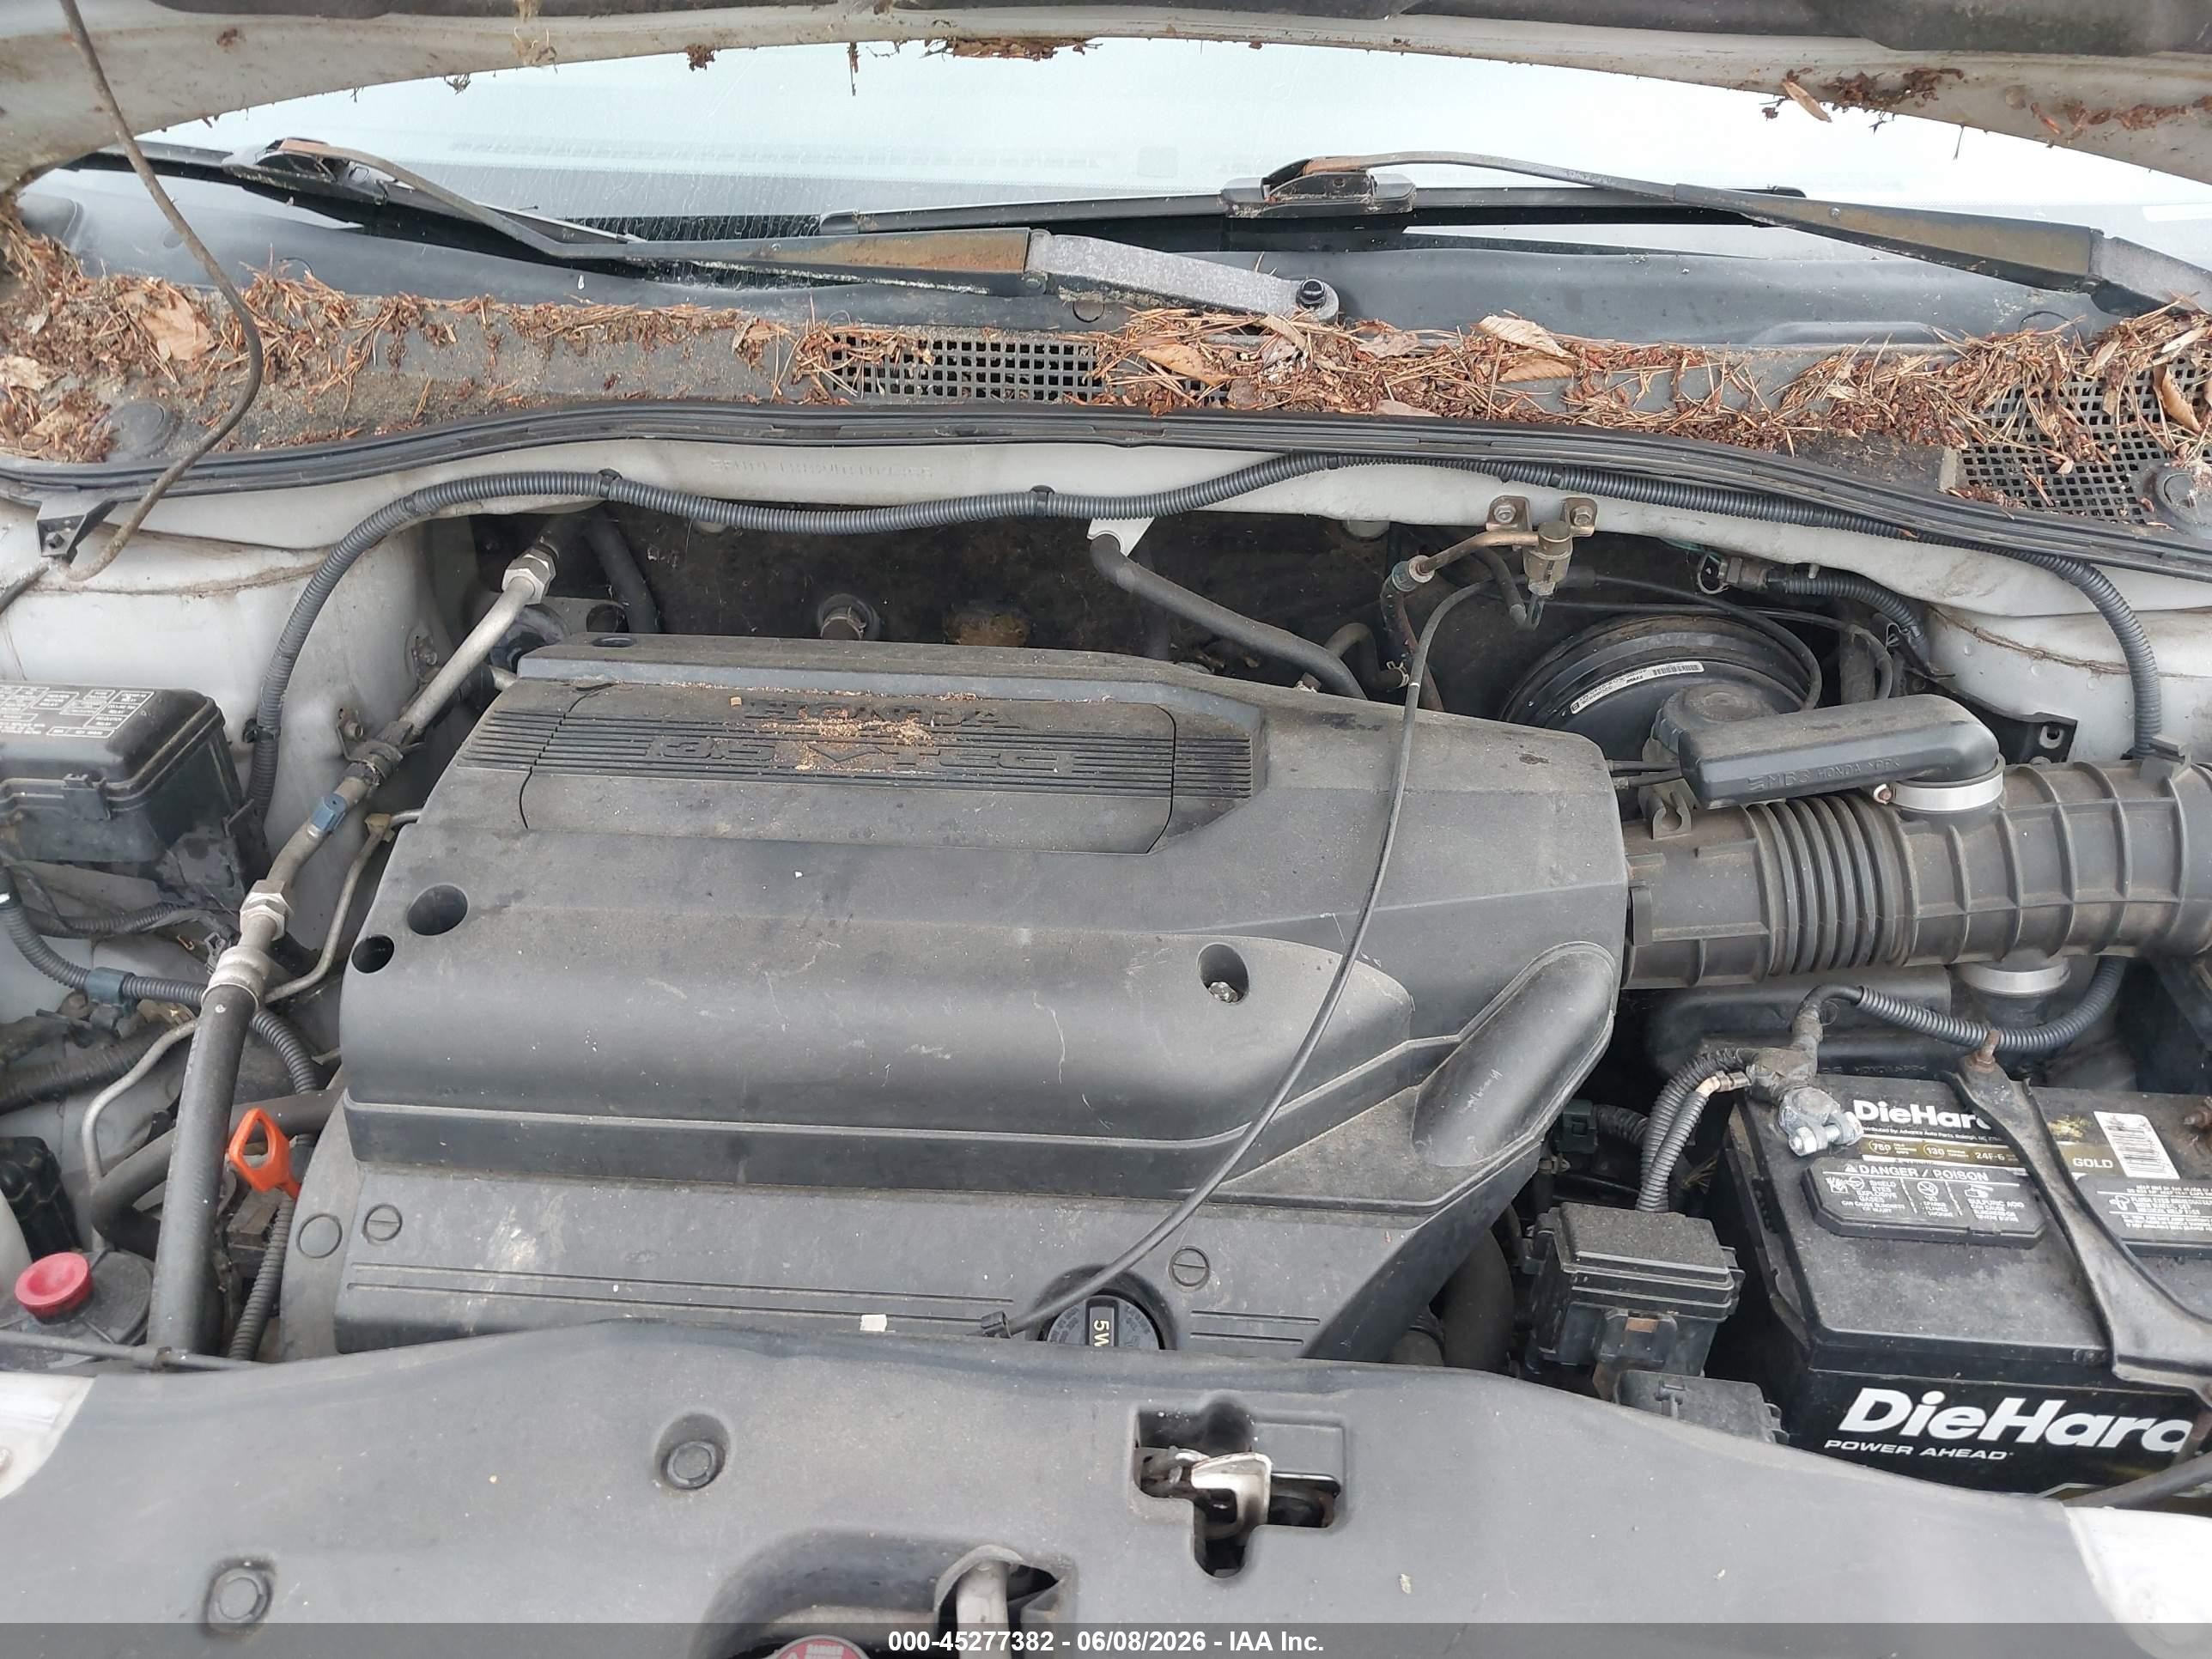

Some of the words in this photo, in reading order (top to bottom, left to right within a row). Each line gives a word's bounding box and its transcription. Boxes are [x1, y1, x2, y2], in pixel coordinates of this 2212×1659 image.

[1817, 763, 1862, 779] HONDA
[1926, 1146, 1945, 1156] 130
[2072, 1158, 2114, 1169] GOLD
[1859, 1164, 1918, 1177] DANGER
[1921, 1168, 1929, 1177] /
[1933, 1170, 1989, 1182] POISON
[1823, 1439, 1914, 1455] POWER
